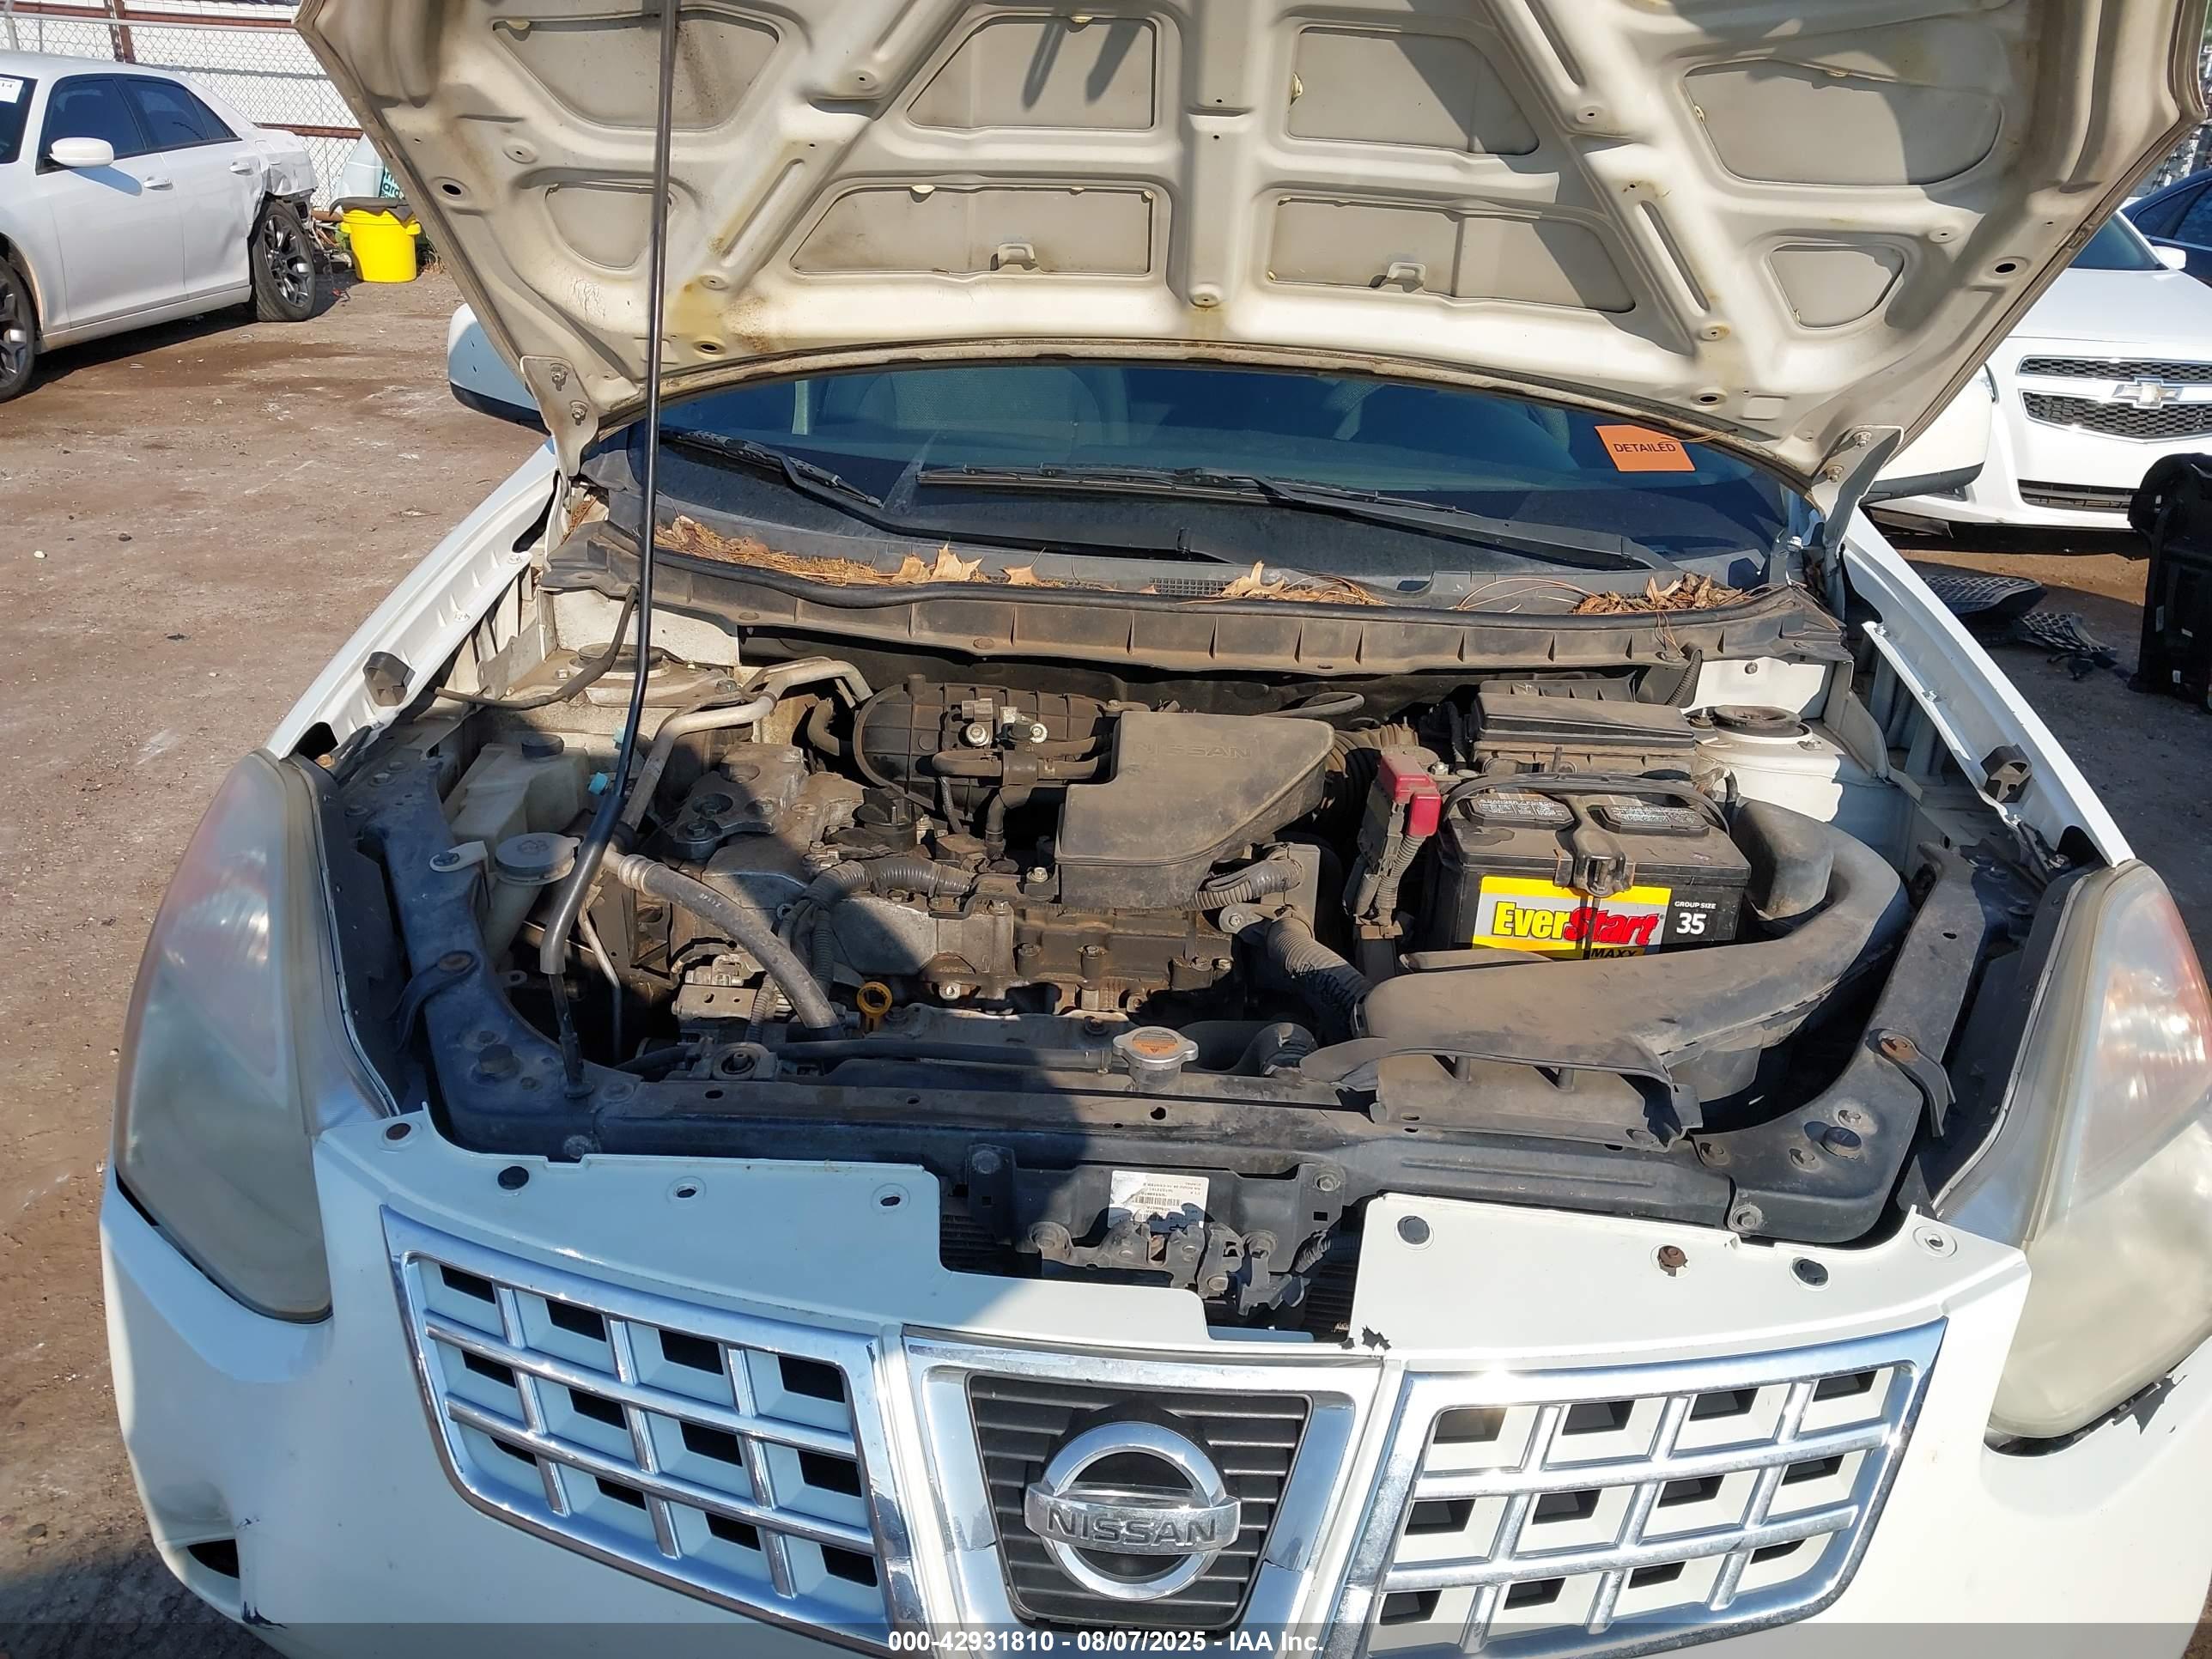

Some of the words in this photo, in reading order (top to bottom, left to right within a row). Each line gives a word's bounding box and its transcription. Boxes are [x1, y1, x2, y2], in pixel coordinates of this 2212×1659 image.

[1613, 443, 1676, 453] DETAILED
[1492, 901, 1660, 946] EverStart
[1676, 912, 1707, 935] 35
[1047, 1506, 1217, 1546] NISSAN
